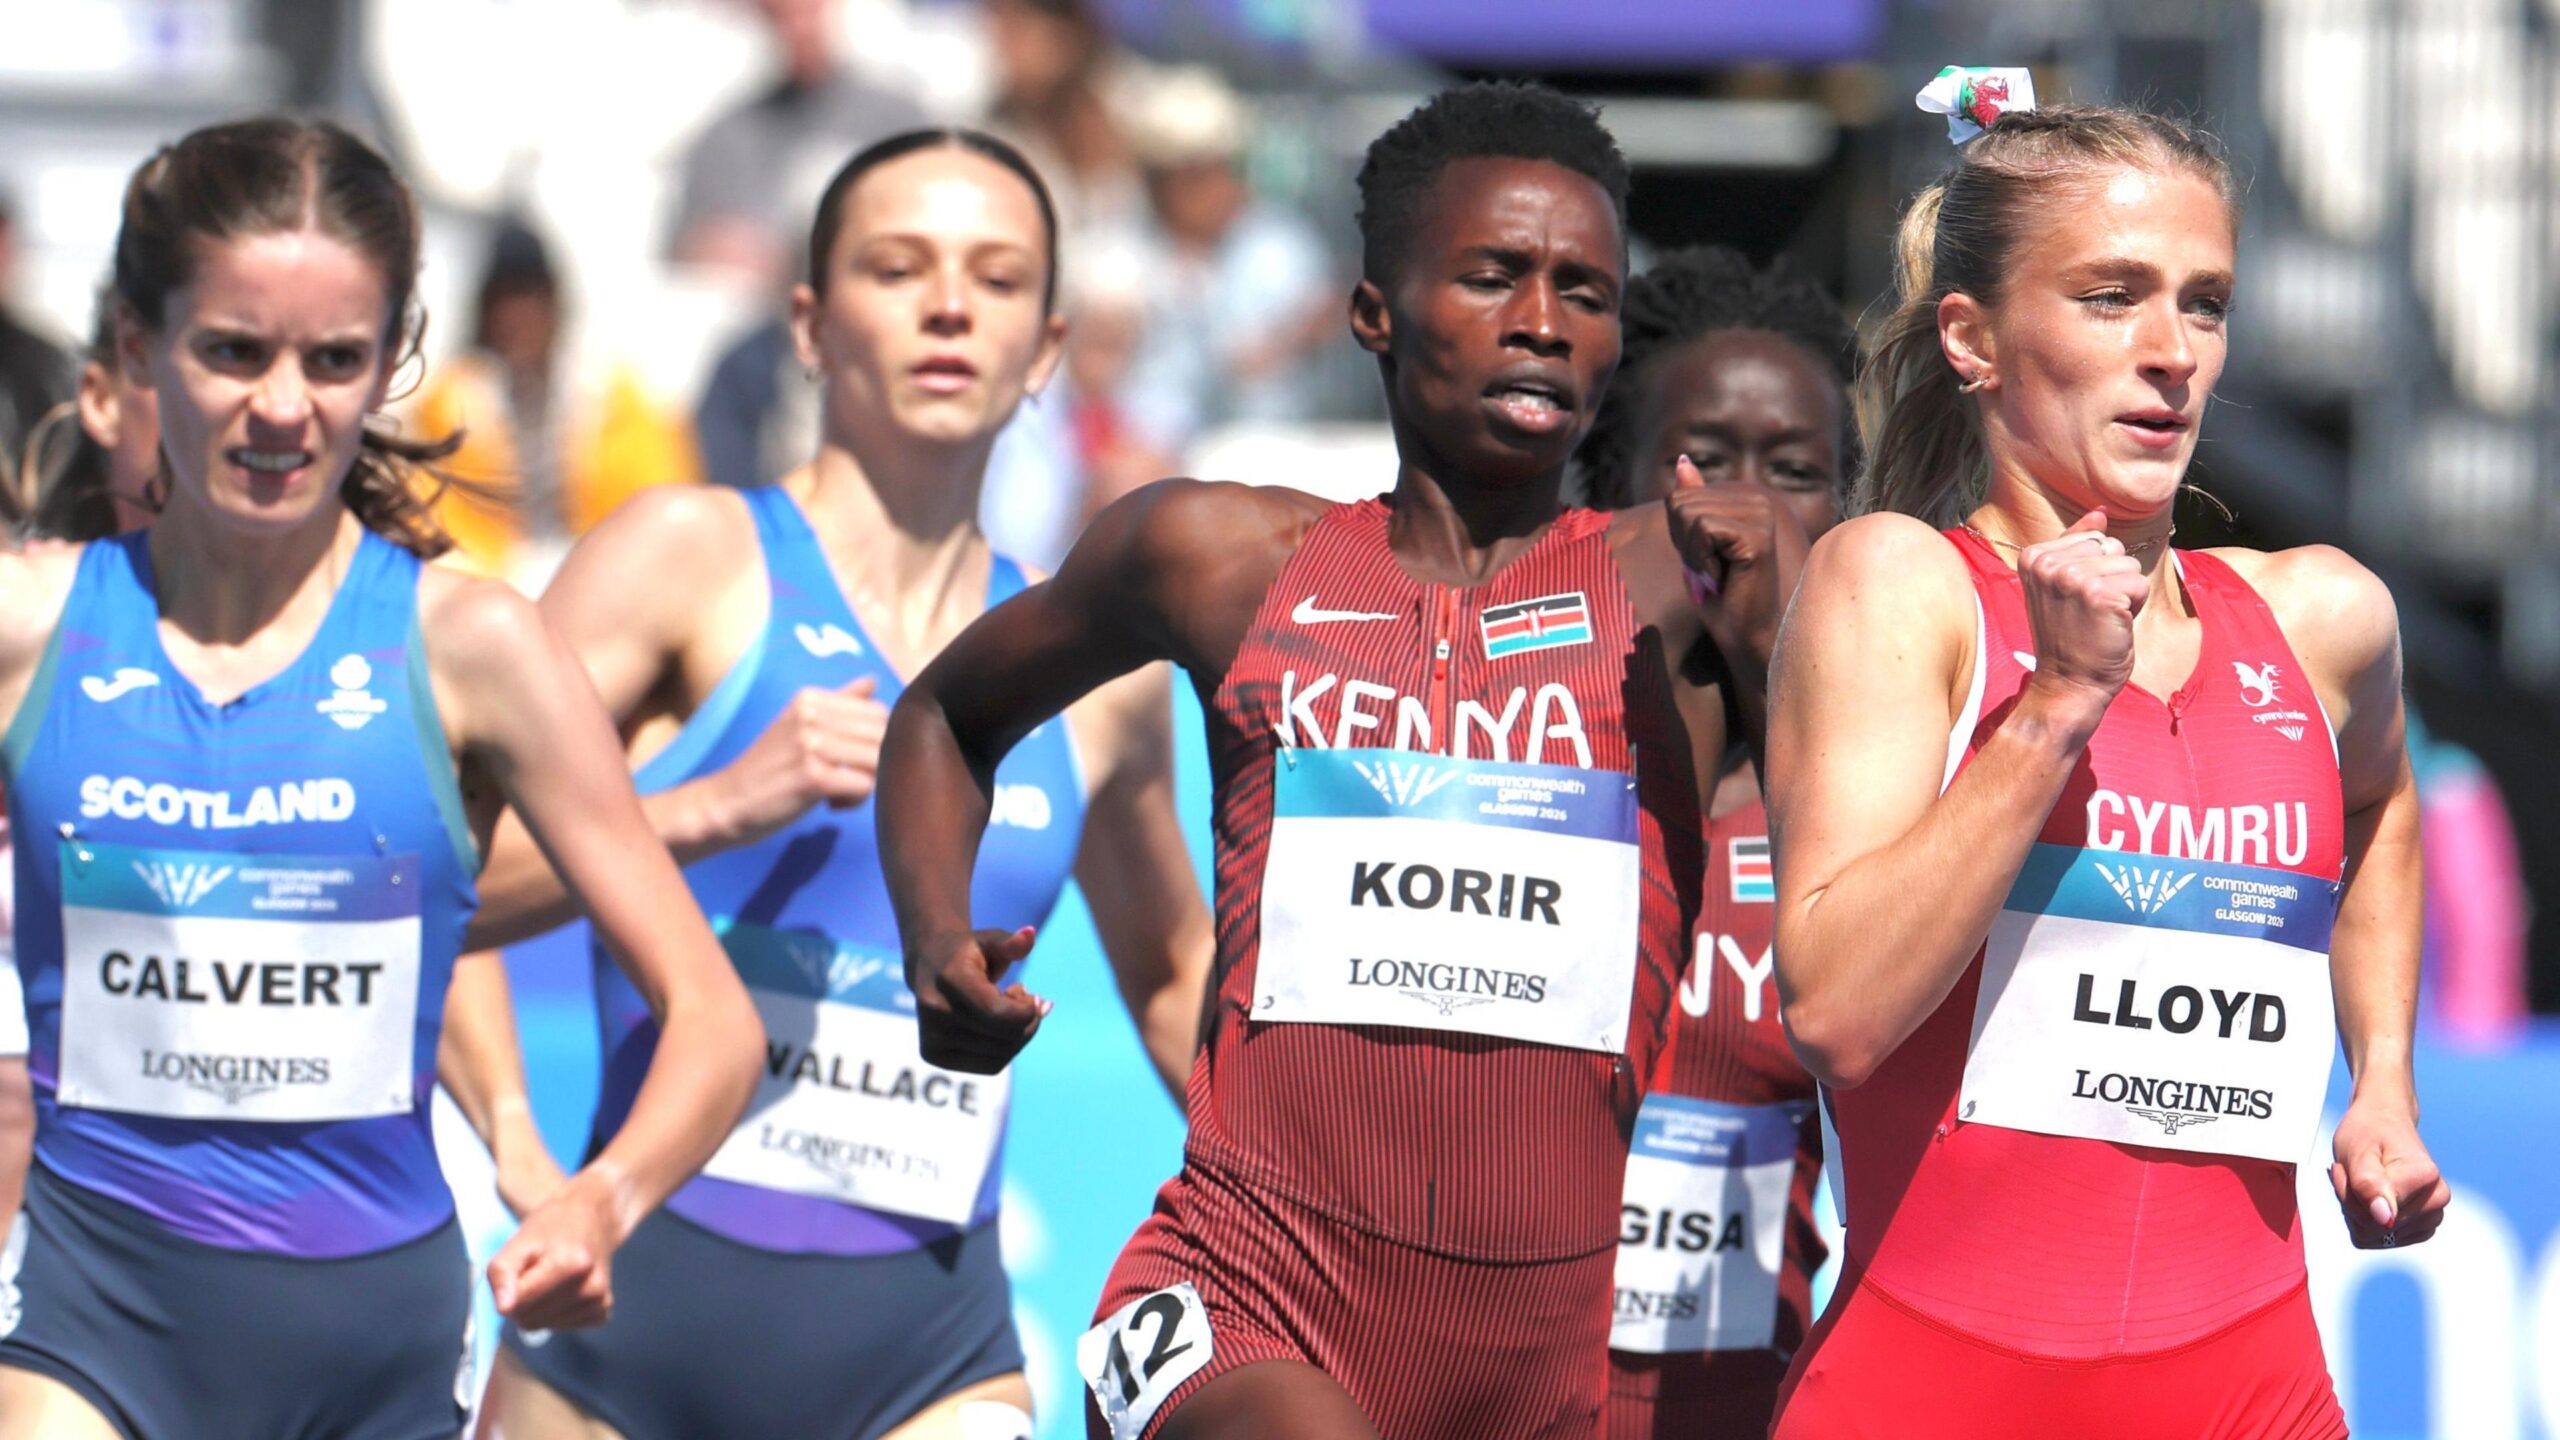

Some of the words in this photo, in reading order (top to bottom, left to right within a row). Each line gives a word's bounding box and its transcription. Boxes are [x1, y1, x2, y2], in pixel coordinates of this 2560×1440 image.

[1281, 670, 1593, 769] KENYA
[79, 775, 356, 829] SCOTLAND
[1466, 773, 1585, 795] commonwealth
[1498, 787, 1553, 803] games
[1539, 807, 1567, 821] 2026
[2086, 789, 2308, 866] CYMRU
[1350, 862, 1562, 926] KORIR
[2203, 876, 2298, 901] commonwealth
[2231, 893, 2276, 909] games
[2215, 909, 2266, 924] GLASGOW
[2267, 915, 2284, 928] 2026
[101, 952, 383, 1006] CALVERT
[1348, 958, 1548, 1003] LONGINES
[2073, 973, 2287, 1043] LLOYD
[140, 1050, 331, 1085] LONGINES
[2072, 1069, 2273, 1120] LONGINES
